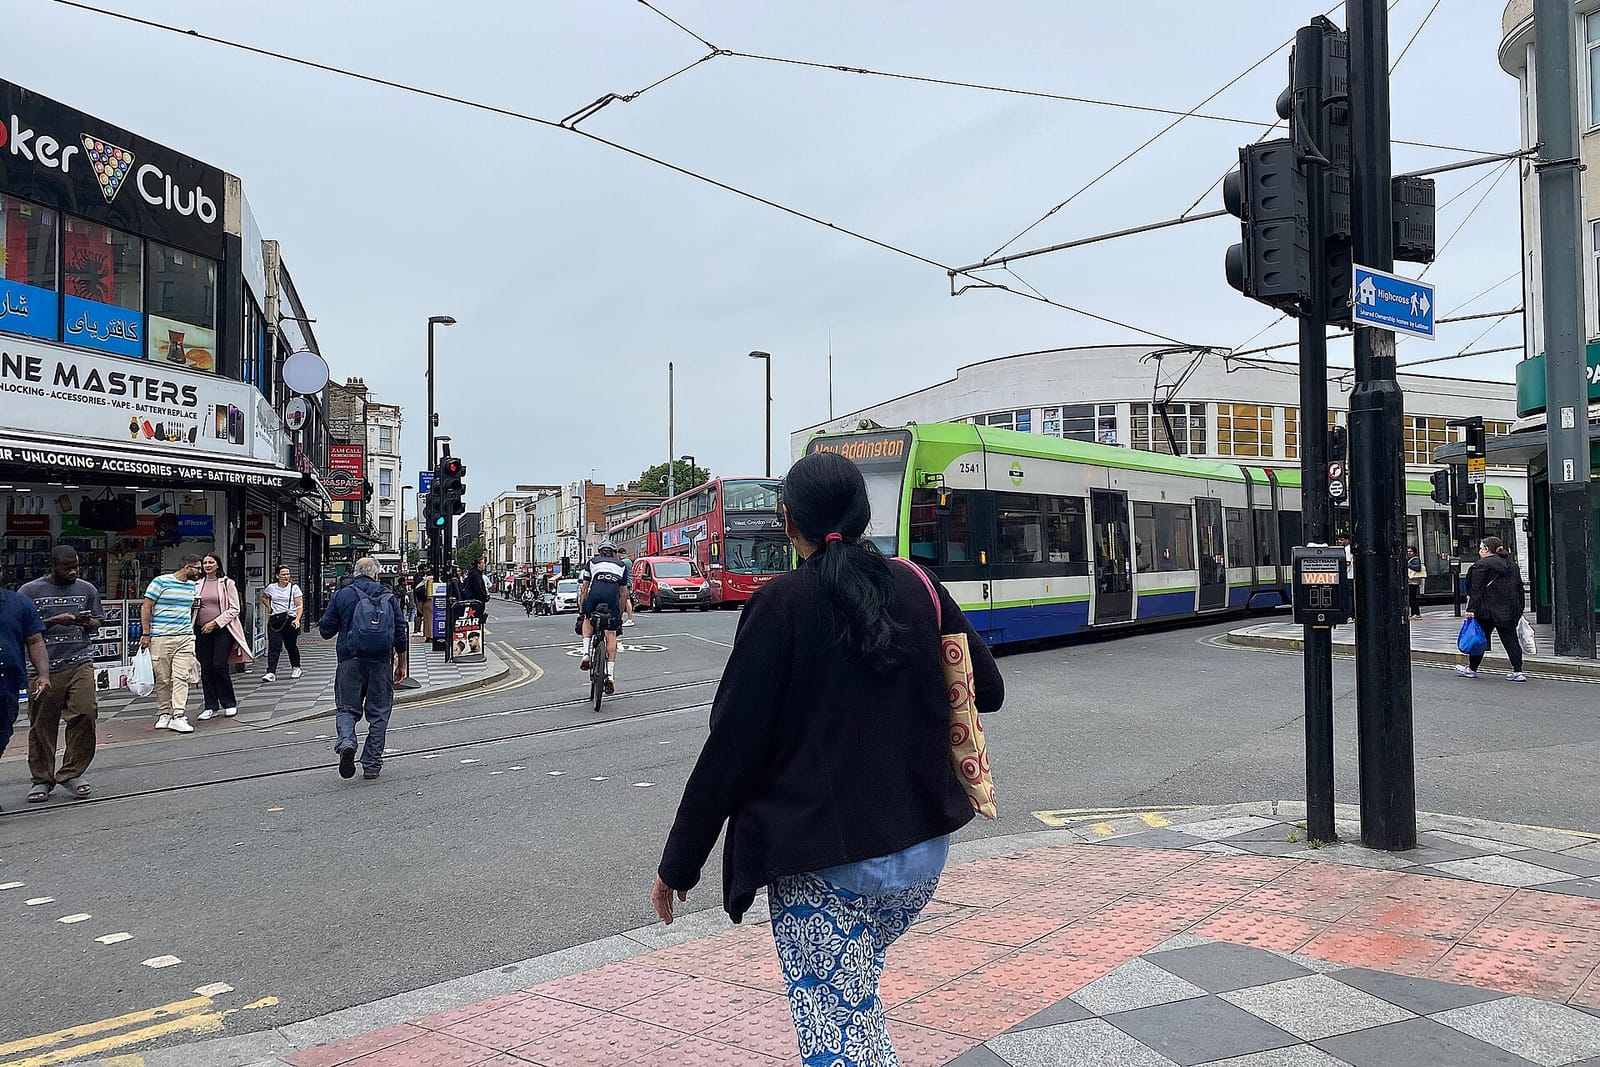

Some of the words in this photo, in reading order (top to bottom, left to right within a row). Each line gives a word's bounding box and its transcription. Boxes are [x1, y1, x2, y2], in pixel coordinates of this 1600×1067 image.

[0, 114, 79, 173] ker
[136, 163, 217, 224] Club
[1378, 288, 1410, 306] Highcross
[2, 352, 43, 383] NE
[53, 361, 198, 408] MASTERS
[50, 390, 106, 407] ACCESSORIES
[111, 399, 131, 410] VAPE
[135, 403, 167, 415] BATTERY
[167, 408, 198, 420] REPLACE
[841, 438, 904, 459] Addington
[0, 447, 14, 461] IR
[22, 450, 95, 468] UNLOCKING
[101, 459, 172, 477] ACCESSORIES
[178, 468, 203, 480] VAPE
[208, 471, 246, 484] BATTERY
[247, 474, 283, 488] REPLACE
[959, 463, 980, 474] 2541
[379, 564, 398, 573] KFC
[1304, 573, 1336, 583] WAIT
[455, 618, 479, 627] STAR
